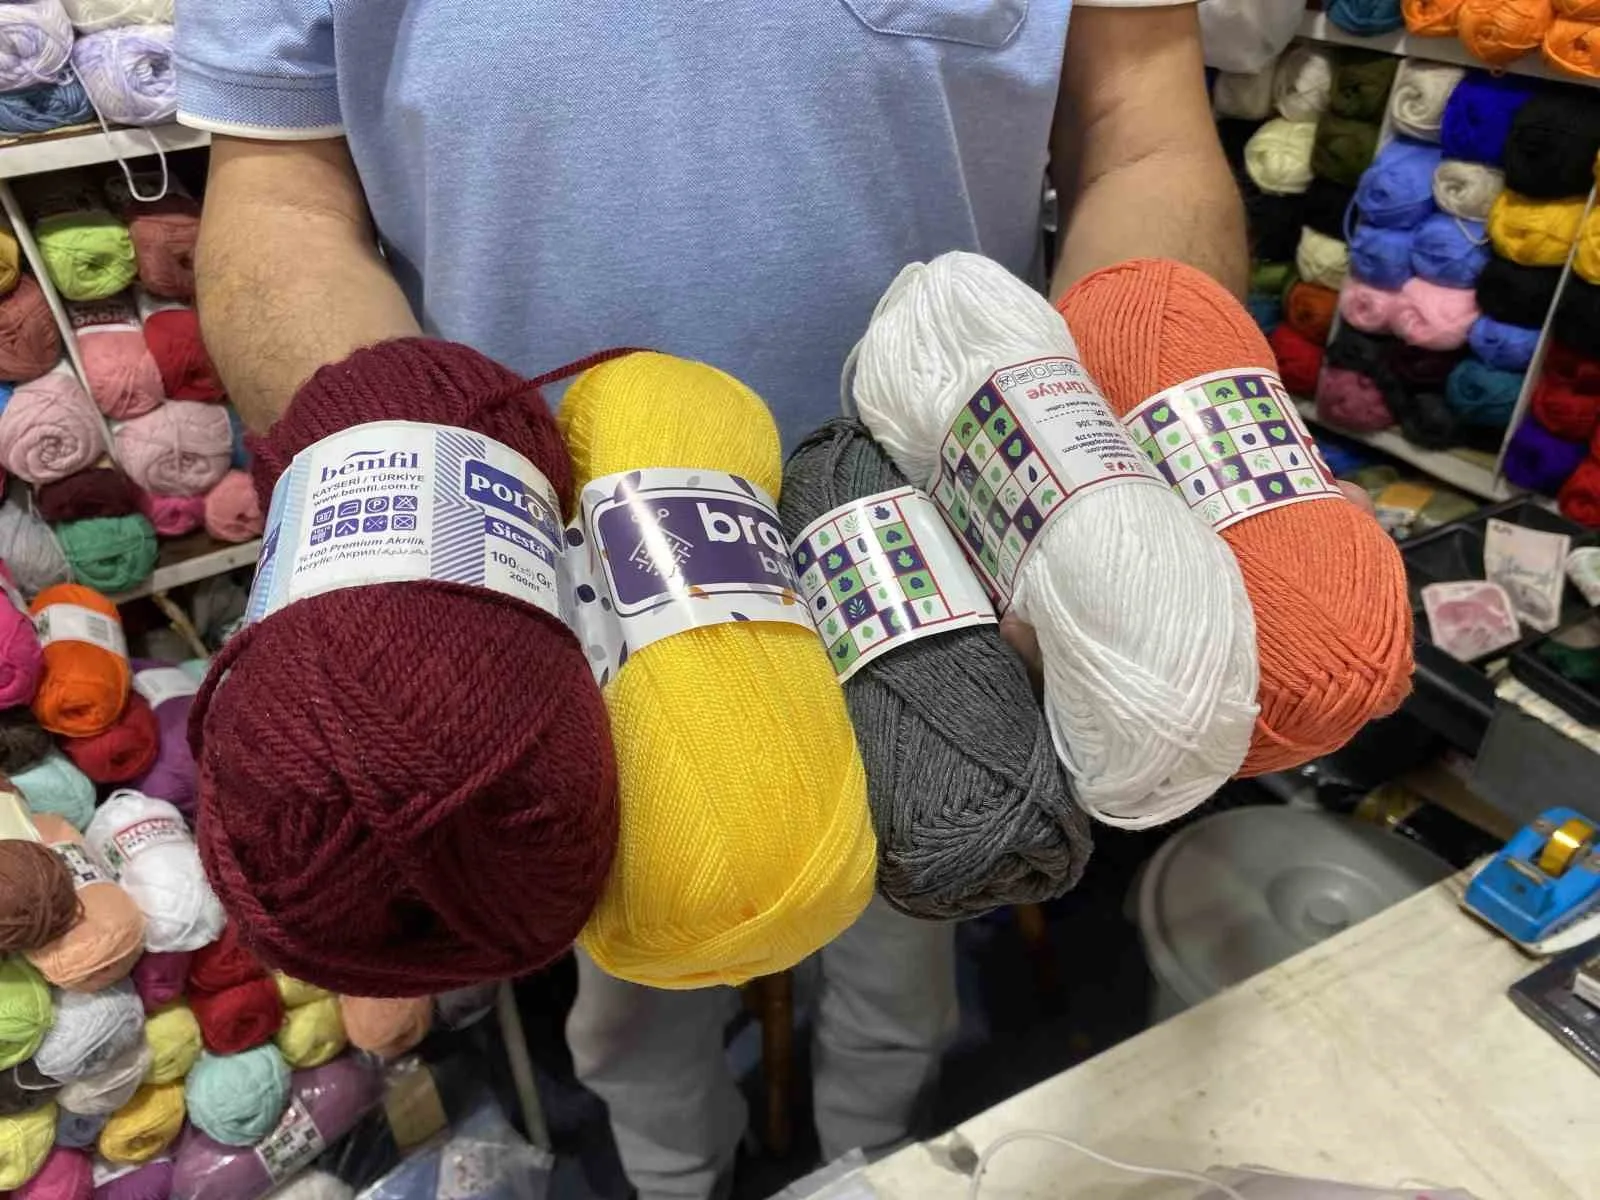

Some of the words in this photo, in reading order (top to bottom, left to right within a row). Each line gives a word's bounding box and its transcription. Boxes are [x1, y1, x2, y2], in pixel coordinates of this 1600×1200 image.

[1027, 381, 1092, 400] Türkiye
[320, 450, 418, 483] bemfil
[370, 472, 424, 483] TÜRKİYE
[313, 483, 420, 507] www.bemfil.com.tr
[470, 472, 544, 521] POLO
[329, 539, 383, 554] Premium
[384, 535, 425, 546] Akrilik
[492, 521, 546, 561] Siesta
[295, 555, 334, 575] Acrylic
